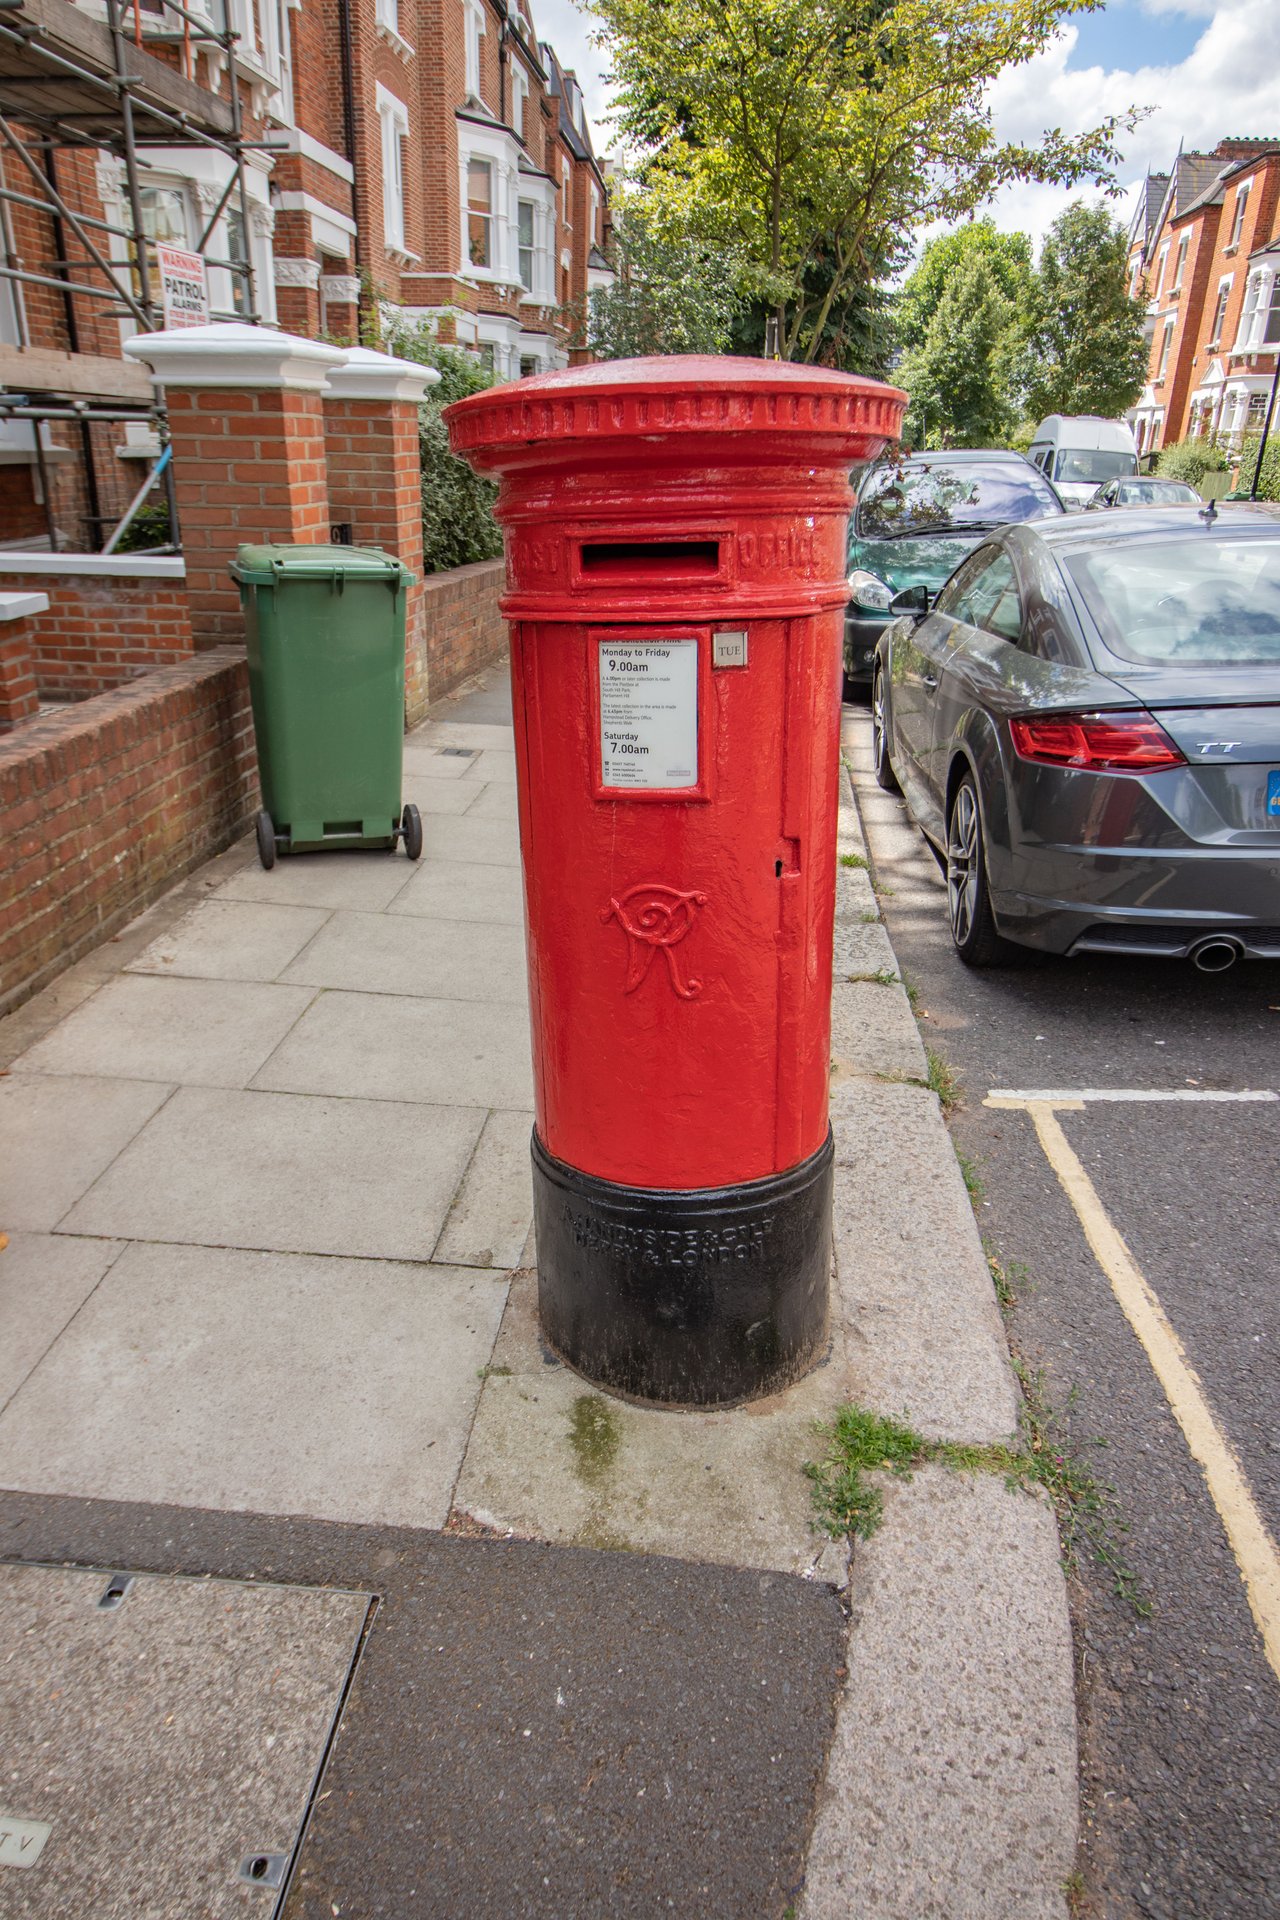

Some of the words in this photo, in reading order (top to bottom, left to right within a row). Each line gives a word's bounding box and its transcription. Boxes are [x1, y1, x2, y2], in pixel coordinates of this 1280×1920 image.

[162, 251, 202, 273] WARNING
[164, 277, 206, 300] PATROL
[172, 298, 202, 312] ALARMS
[602, 648, 633, 658] Monday
[635, 649, 643, 657] to
[645, 649, 671, 658] Friday
[718, 646, 741, 657] TUE
[609, 659, 649, 672] 9.00am
[604, 732, 639, 742] Saturday
[610, 742, 649, 754] 7.00am
[1196, 742, 1242, 754] TT
[643, 1249, 663, 1267] &
[667, 1240, 763, 1266] LONDON
